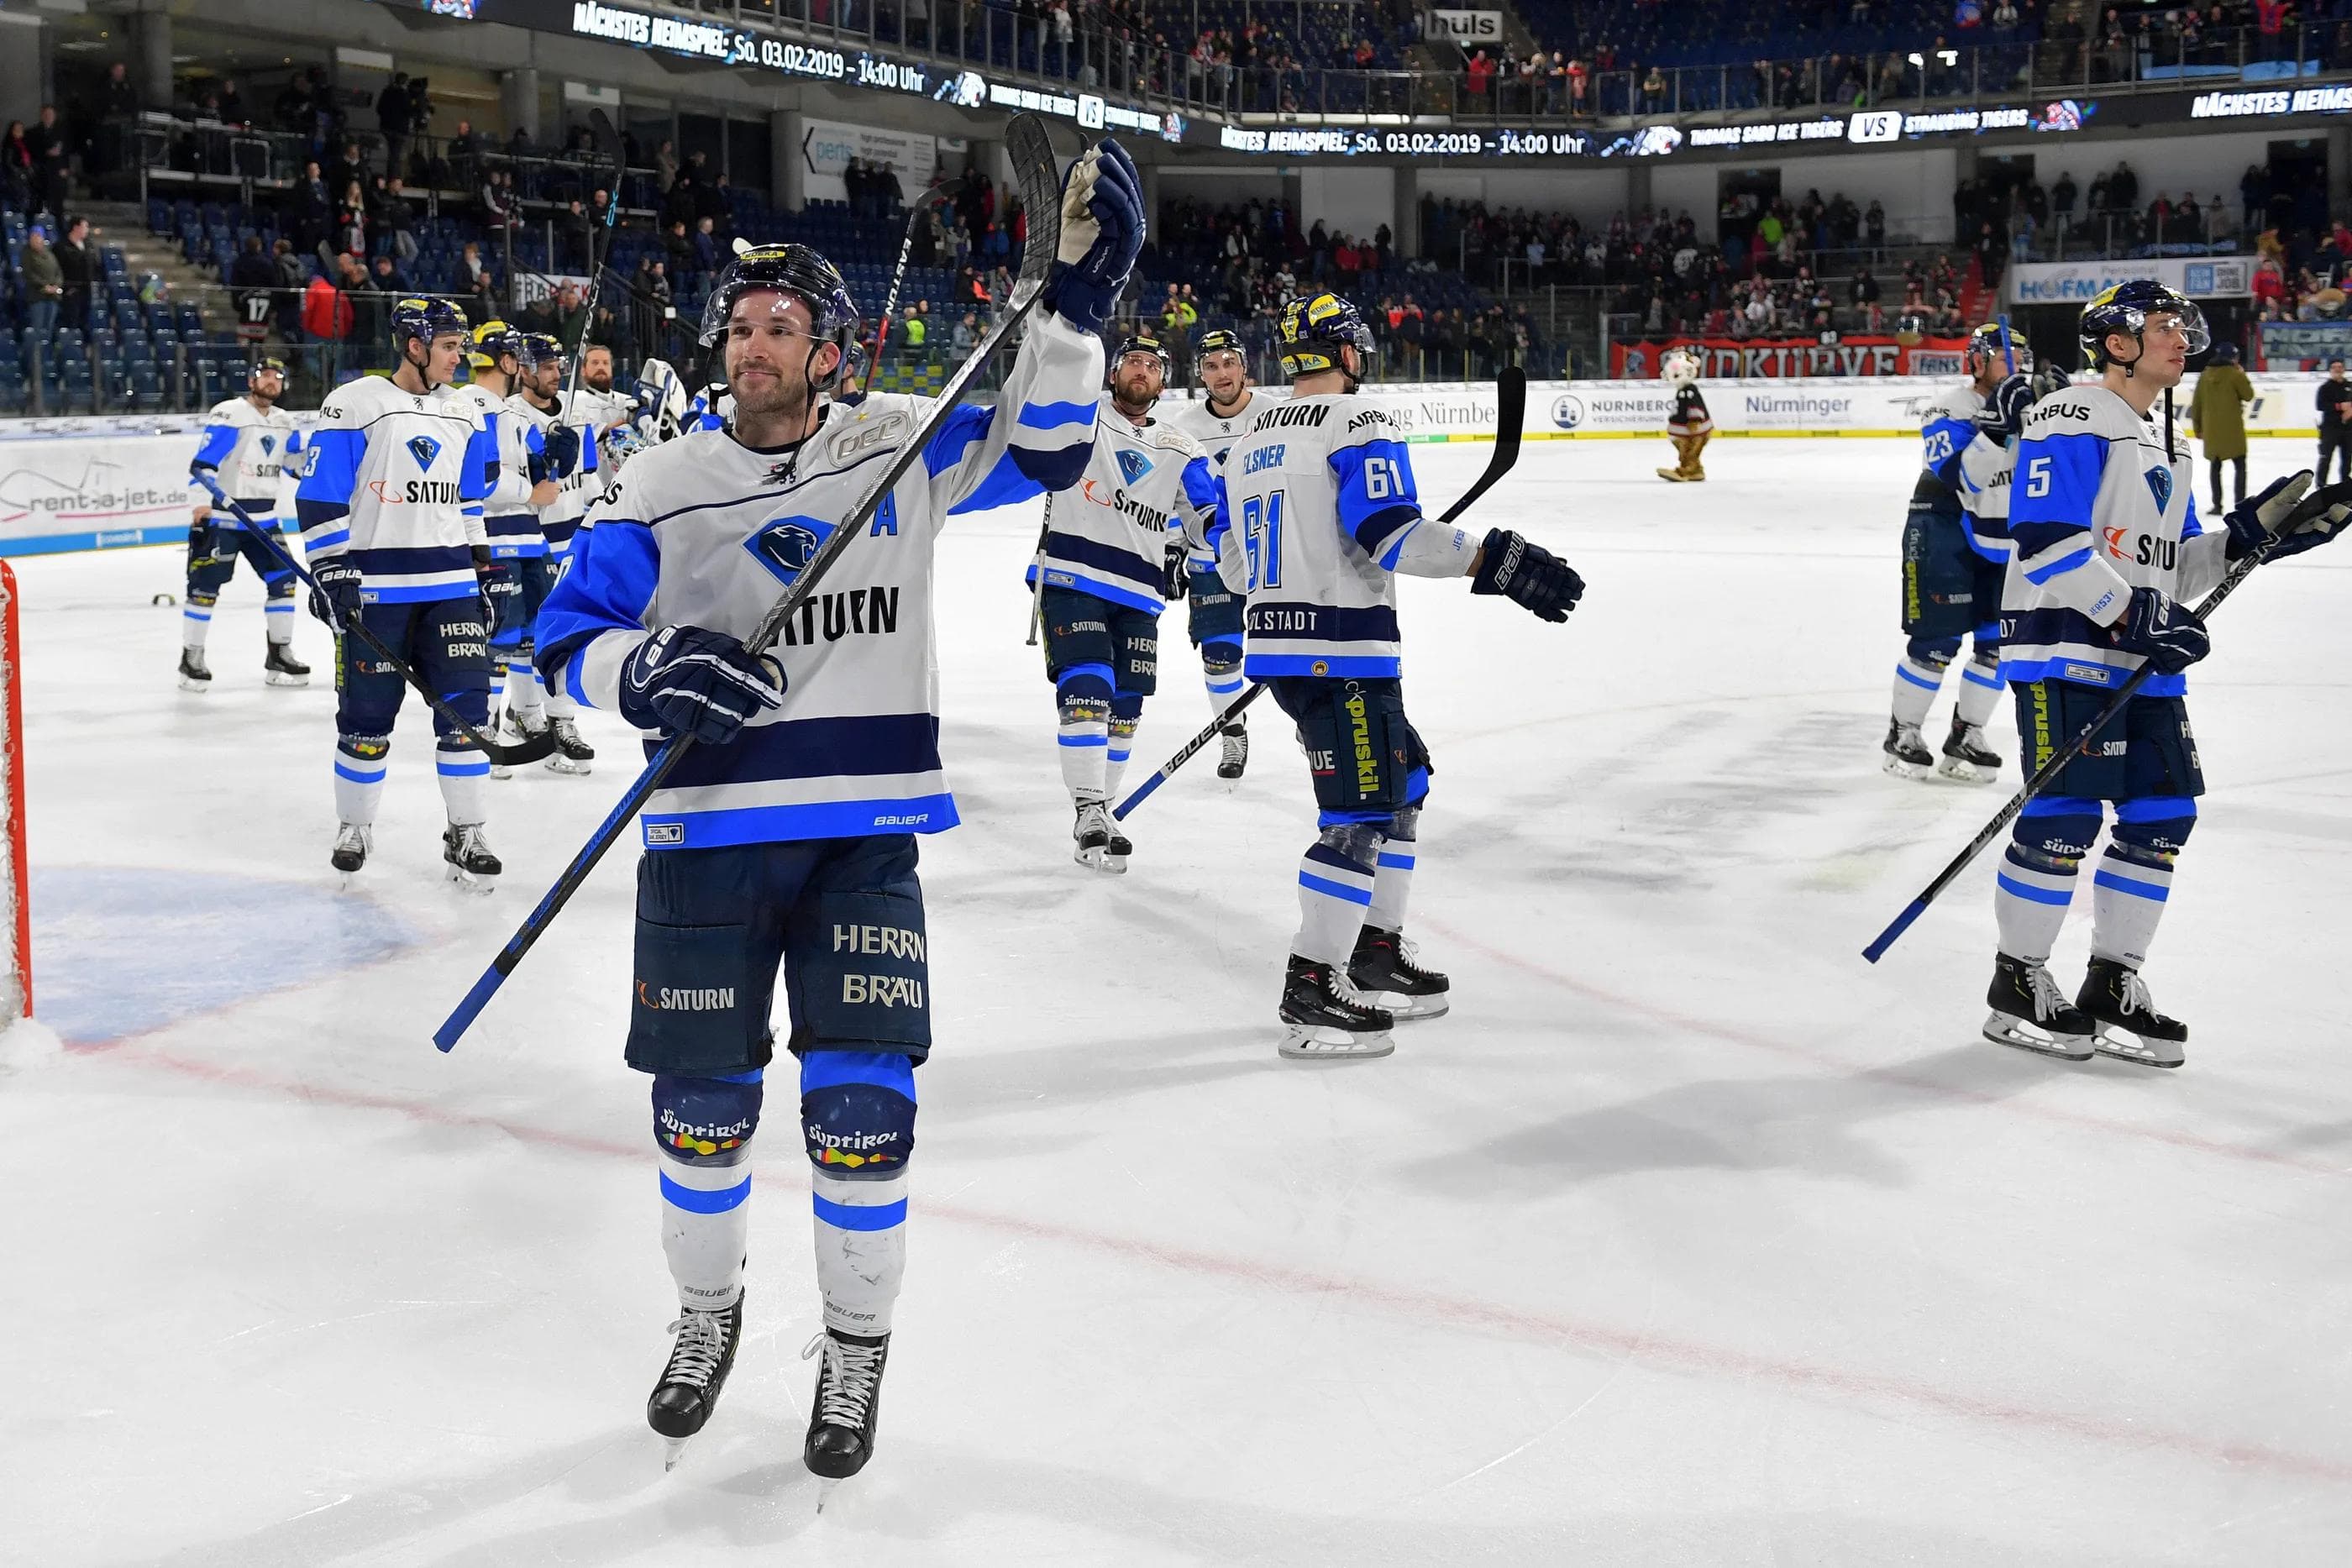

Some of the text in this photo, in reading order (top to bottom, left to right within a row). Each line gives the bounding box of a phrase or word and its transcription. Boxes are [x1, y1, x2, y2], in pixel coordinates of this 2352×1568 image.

[573, 2, 651, 43] NÄCHSTES
[651, 17, 729, 57] HEIMSPIEL:
[734, 34, 759, 63] So.
[762, 39, 844, 78] 03.02.2019
[858, 58, 897, 87] 14:00
[900, 66, 925, 92] Uhr
[2191, 87, 2352, 118] NÄCHSTES HEIMS
[1863, 117, 1887, 137] VS
[1356, 133, 1382, 152] So.
[1387, 134, 1481, 153] 03.02.2019
[1499, 134, 1548, 154] 14:00
[1551, 134, 1585, 155] Uhr
[247, 298, 269, 323] 17
[1254, 404, 1331, 433] SATURN
[1420, 401, 1496, 426] Nürnbe
[1746, 396, 1851, 415] Nürminger
[837, 422, 901, 460] DEL
[1925, 429, 1955, 463] 23
[1364, 457, 1406, 500] 61
[2026, 456, 2054, 498] 5
[30, 488, 188, 511] rent-a-jet.de
[870, 490, 898, 537] A
[1242, 490, 1285, 595] 61
[1202, 594, 1231, 606] SATURN
[833, 924, 925, 963] HERRN
[660, 987, 734, 1010] SATURN
[843, 974, 922, 1009] BRÄU
